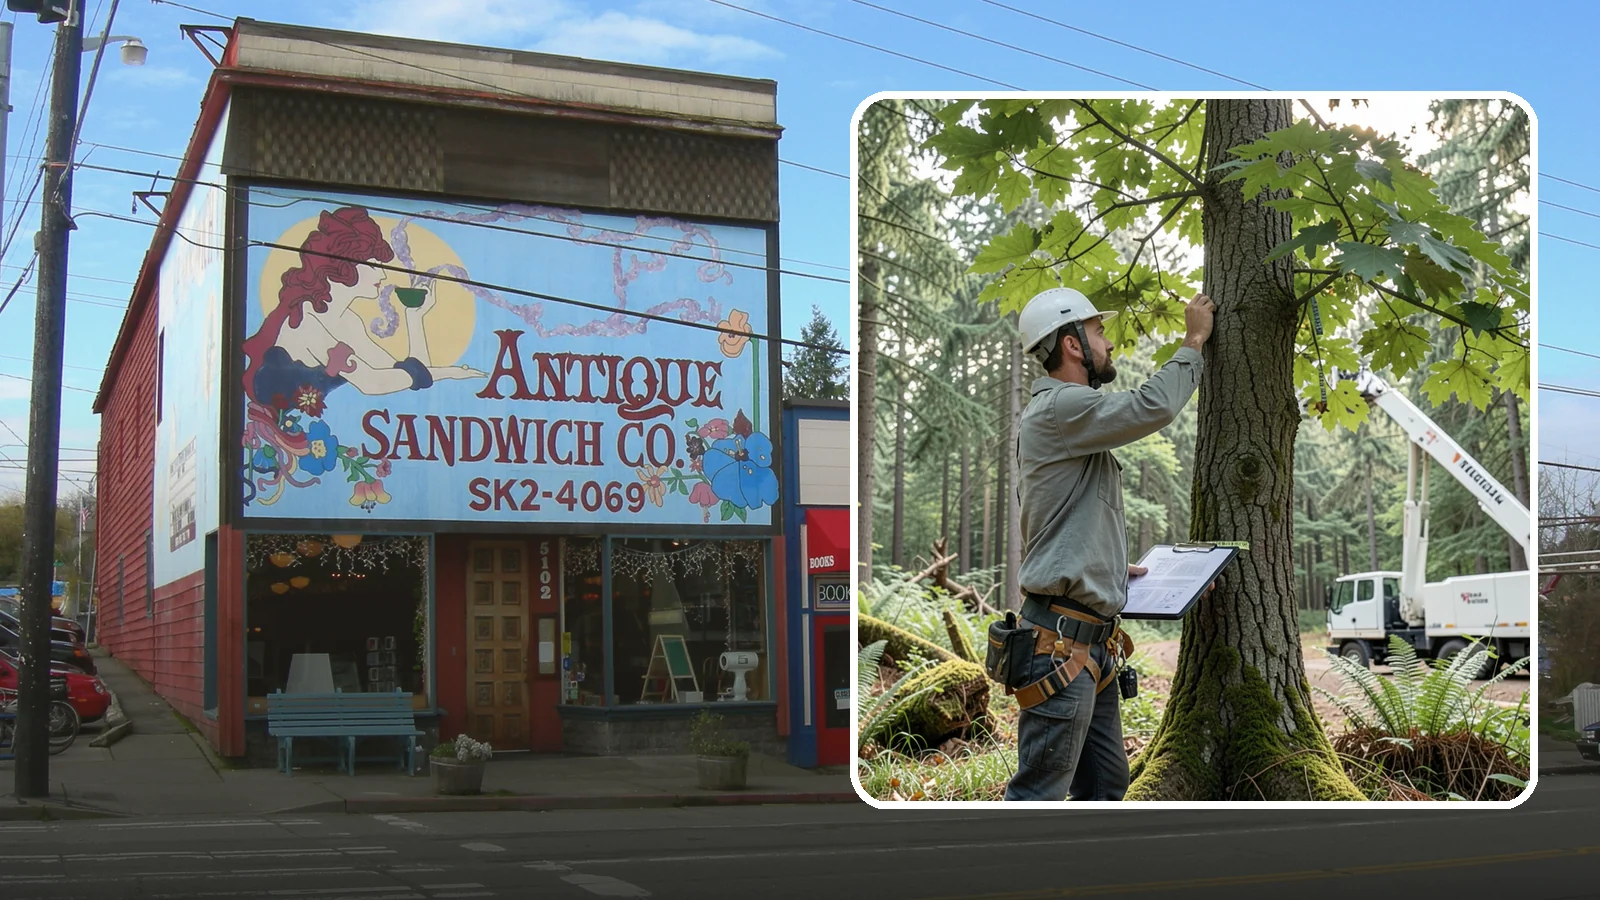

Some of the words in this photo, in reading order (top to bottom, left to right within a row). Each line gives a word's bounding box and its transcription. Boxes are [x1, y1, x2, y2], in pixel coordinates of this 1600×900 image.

[477, 329, 723, 420] ANTIQUE
[361, 408, 605, 467] SANDWICH
[617, 422, 684, 468] CO.
[468, 477, 645, 513] SK2-4069
[540, 542, 551, 599] 5102
[809, 555, 835, 569] BOOKS
